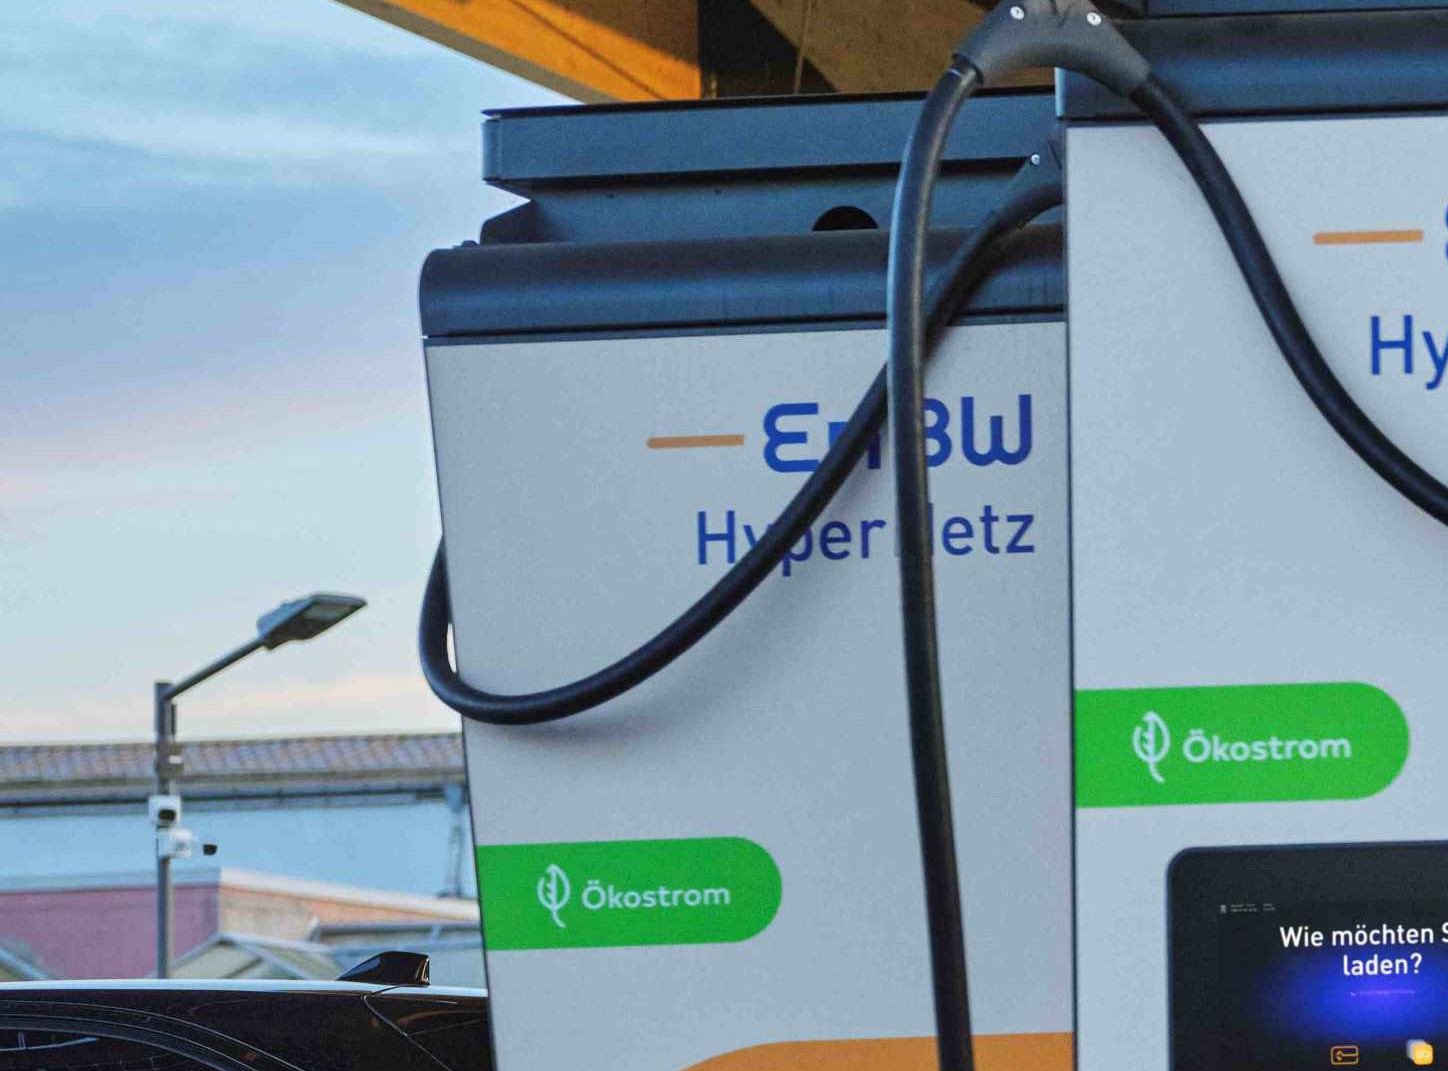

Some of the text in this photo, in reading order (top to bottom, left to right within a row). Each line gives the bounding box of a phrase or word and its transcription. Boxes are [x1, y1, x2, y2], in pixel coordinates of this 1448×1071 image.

[697, 503, 1035, 577] Hperetz
[1183, 728, 1351, 764] Ökostrom
[581, 881, 730, 911] Ökostrom
[1280, 926, 1324, 948] Wie
[1331, 923, 1435, 946] möchten
[1343, 953, 1423, 976] laden?
